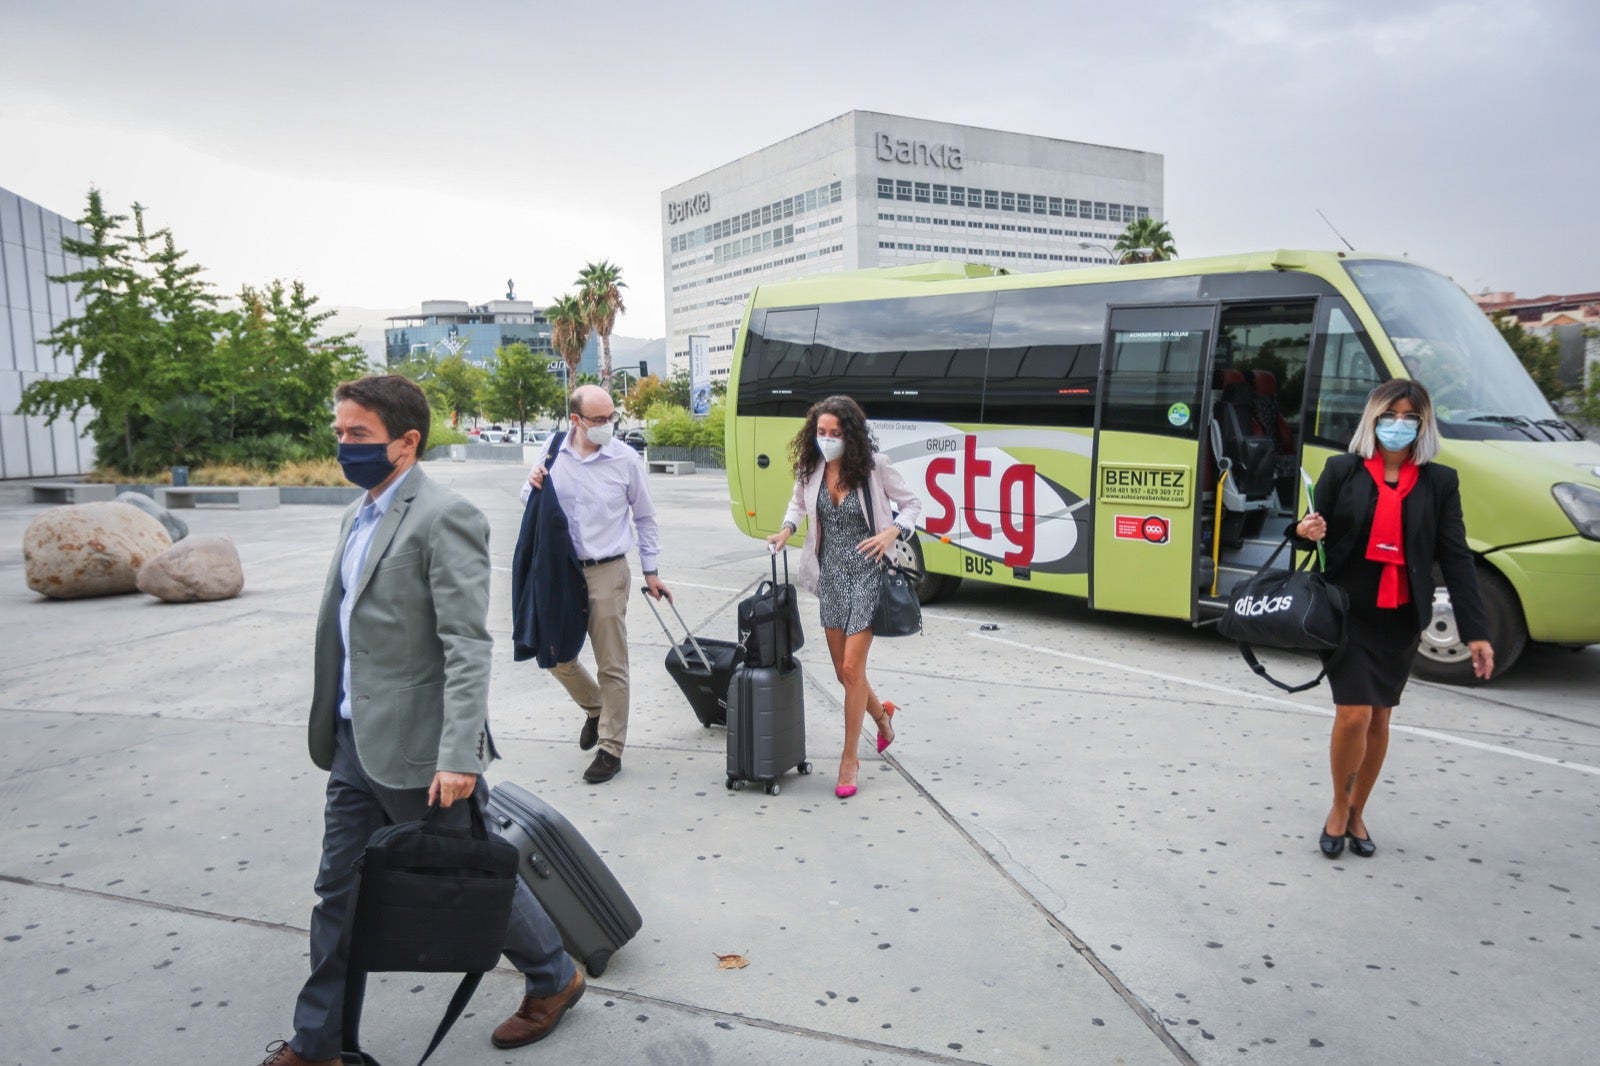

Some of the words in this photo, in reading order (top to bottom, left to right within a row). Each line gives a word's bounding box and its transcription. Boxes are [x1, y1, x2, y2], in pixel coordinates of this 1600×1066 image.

[875, 131, 963, 170] Bankia
[668, 191, 711, 224] Bankia
[926, 439, 957, 451] GRUPO
[1106, 470, 1184, 488] BENITEZ
[925, 435, 1036, 568] stg
[965, 555, 993, 575] BUS
